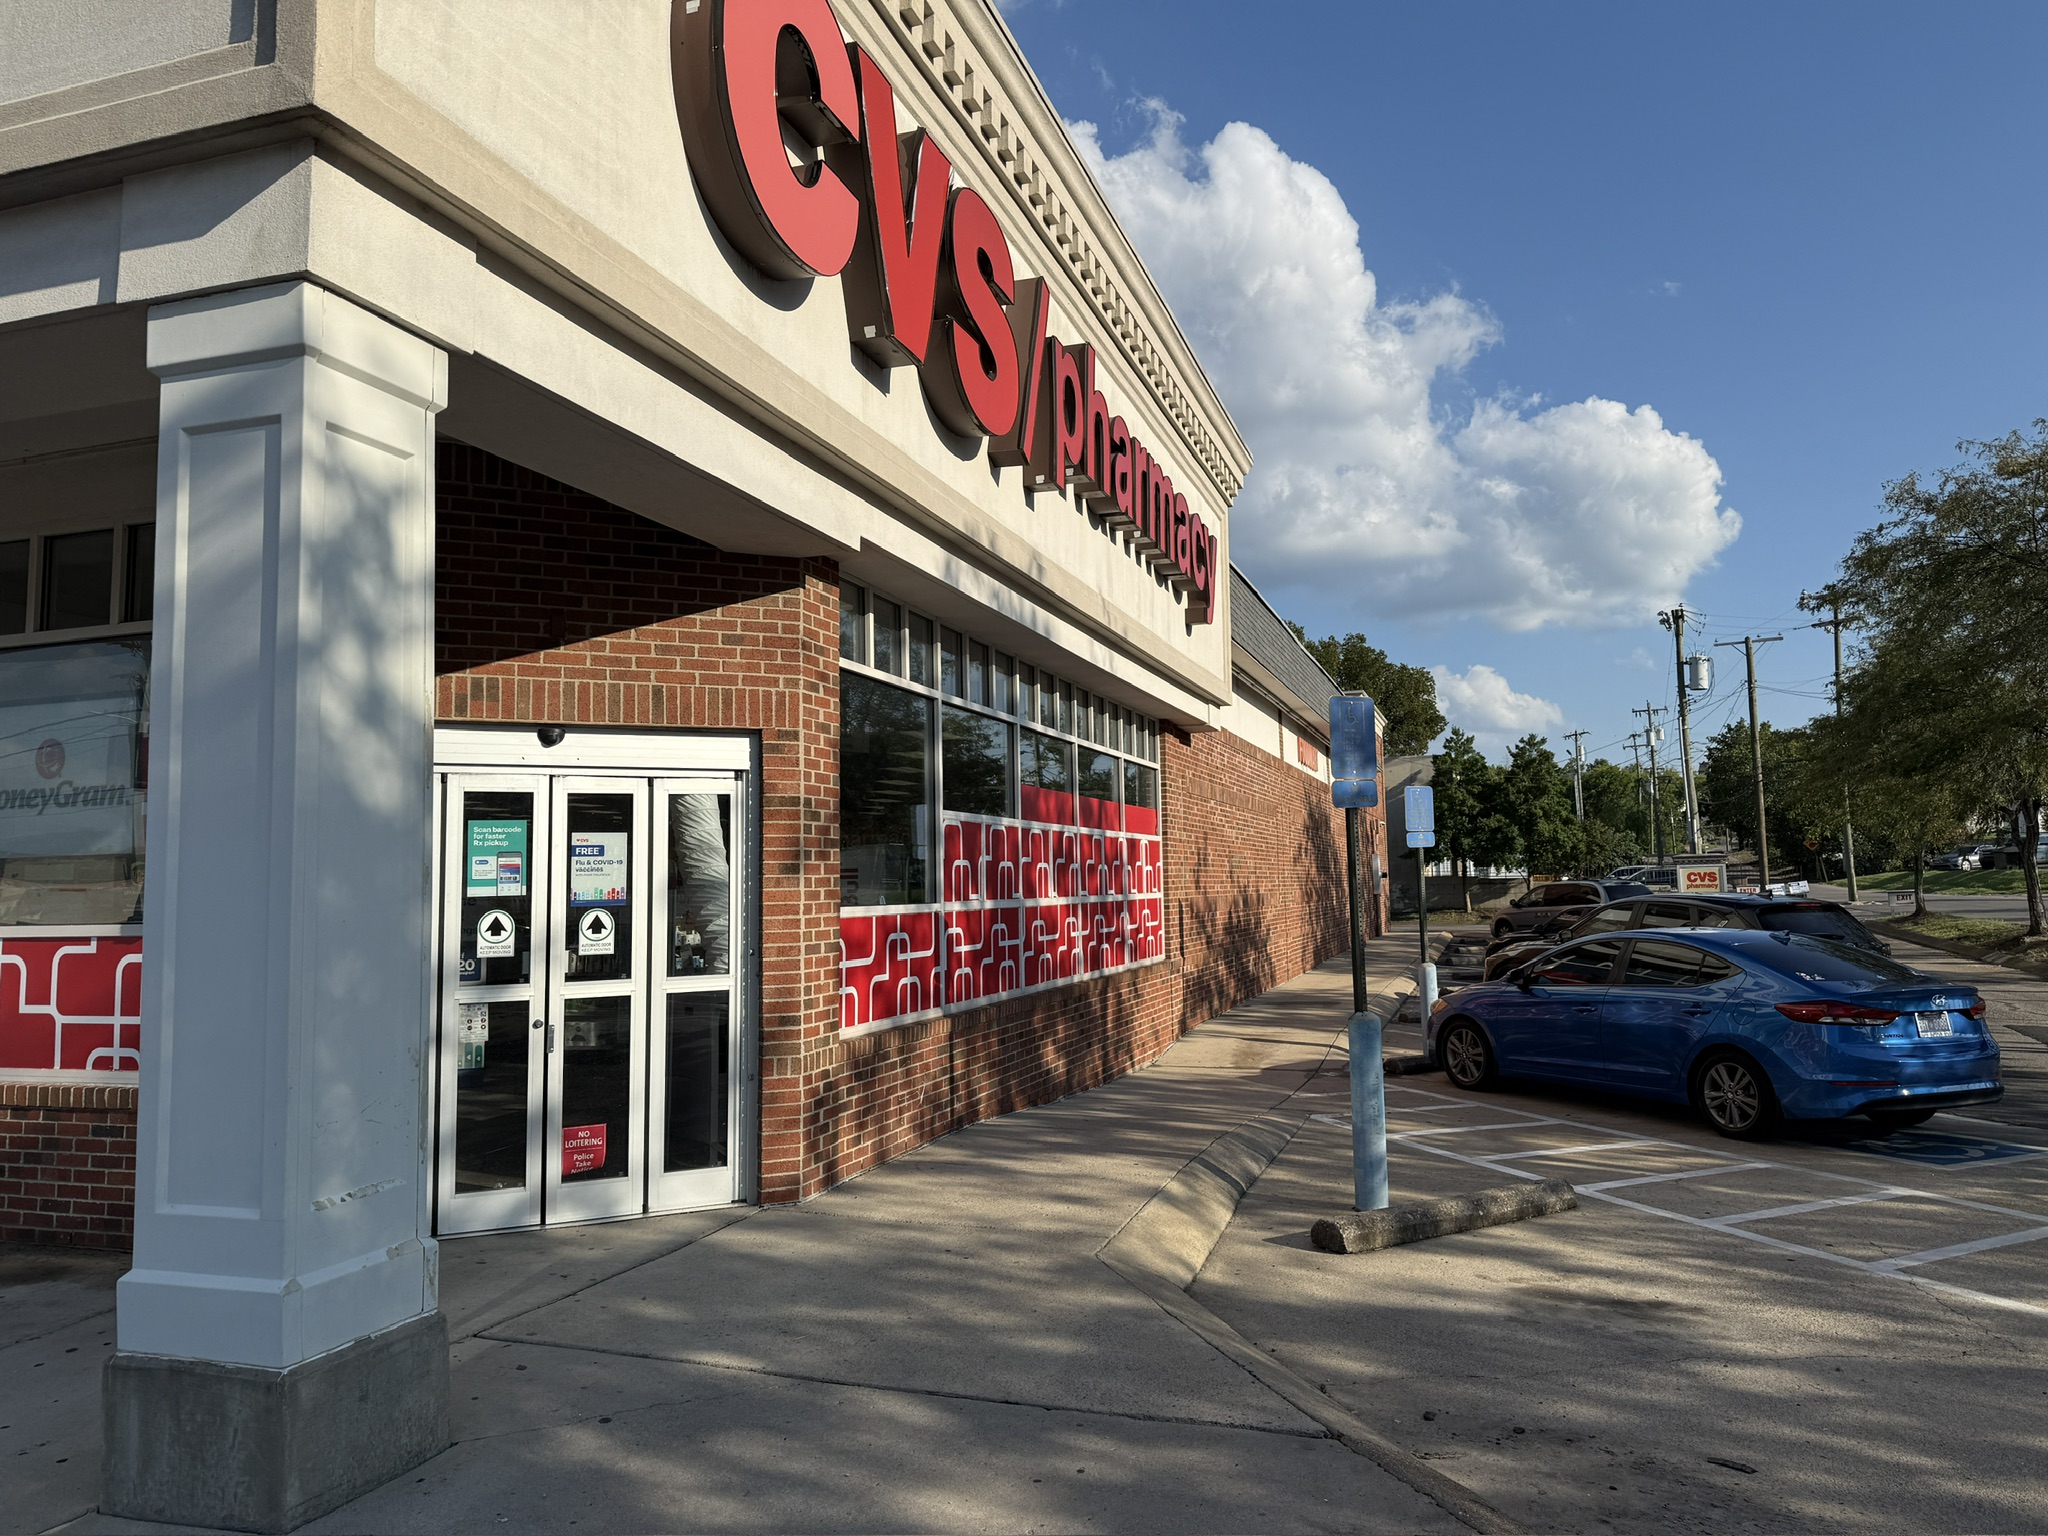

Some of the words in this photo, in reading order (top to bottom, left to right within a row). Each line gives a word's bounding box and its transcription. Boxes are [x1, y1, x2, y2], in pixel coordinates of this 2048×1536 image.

[473, 832, 484, 840] for
[485, 832, 506, 840] faster
[484, 839, 509, 847] pickup
[1686, 871, 1718, 883] CVS
[578, 1130, 590, 1138] NO
[565, 1137, 603, 1148] LOITERING
